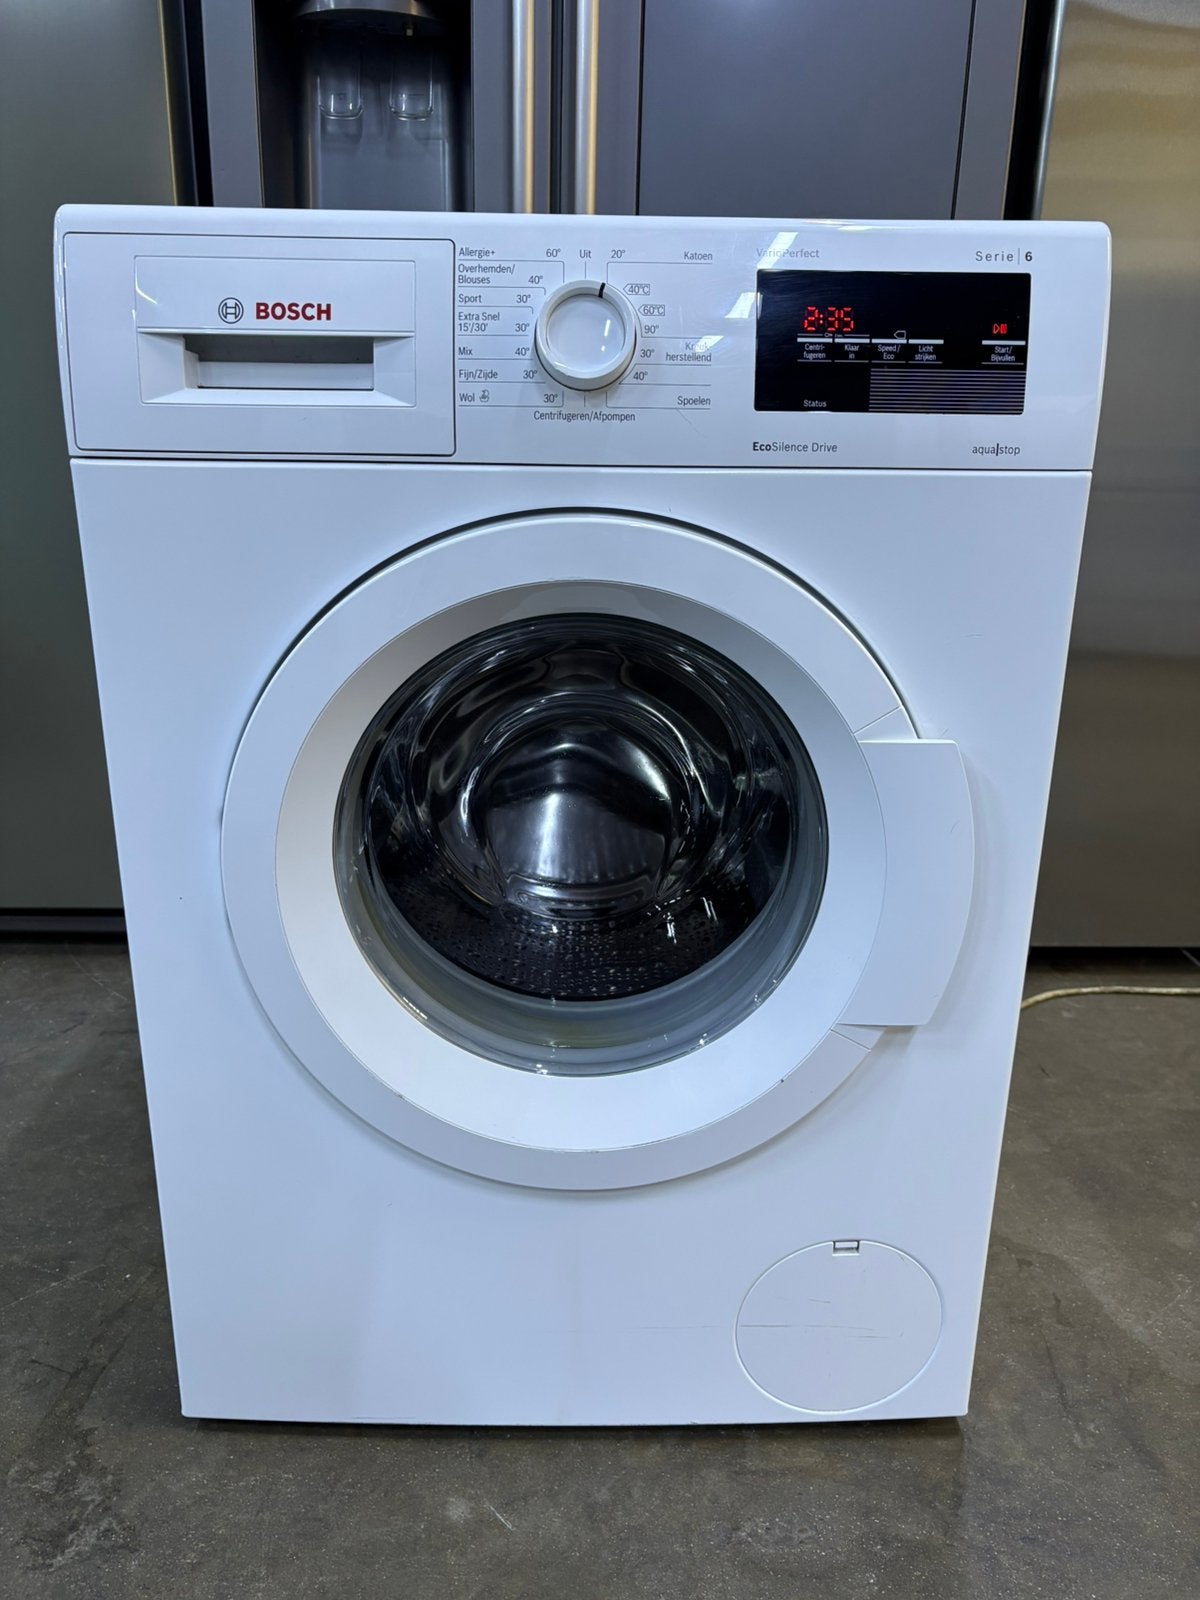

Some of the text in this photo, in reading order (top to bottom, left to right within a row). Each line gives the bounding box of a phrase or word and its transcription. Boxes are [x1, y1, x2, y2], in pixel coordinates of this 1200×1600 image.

[458, 247, 561, 259] Allergie+ 60°
[579, 249, 592, 259] Uit
[610, 249, 626, 259] 20°
[683, 251, 713, 260] Katoen
[756, 248, 820, 258] VarioPerfect
[457, 264, 515, 275] Overhemden/
[457, 275, 543, 285] Blouses 40°
[458, 293, 531, 304] Sport 30°
[255, 302, 332, 321] BOSCH
[458, 311, 500, 321] Extra Snel
[803, 306, 855, 332] 2:35
[514, 322, 530, 333] 30°
[644, 324, 660, 334] 90°
[458, 346, 530, 357] Mix 40°
[844, 344, 860, 352] Klaar
[918, 345, 934, 353] Licht
[994, 346, 1013, 354] Start/
[640, 348, 655, 359] 30°
[665, 351, 712, 362] herstellend
[803, 351, 826, 360] fugeren
[883, 352, 895, 360] Eco
[914, 353, 937, 362] strijken
[990, 354, 1016, 362] Bijvullen
[458, 369, 538, 380] Fijn/Zijde 30°
[633, 371, 649, 381] 40°
[459, 392, 558, 404] Wol 30°
[677, 395, 711, 407] Spoelen
[803, 399, 828, 408] Status
[533, 410, 636, 423] Centrifugeren/Afpompen
[752, 441, 838, 453] EcoSilence Drive
